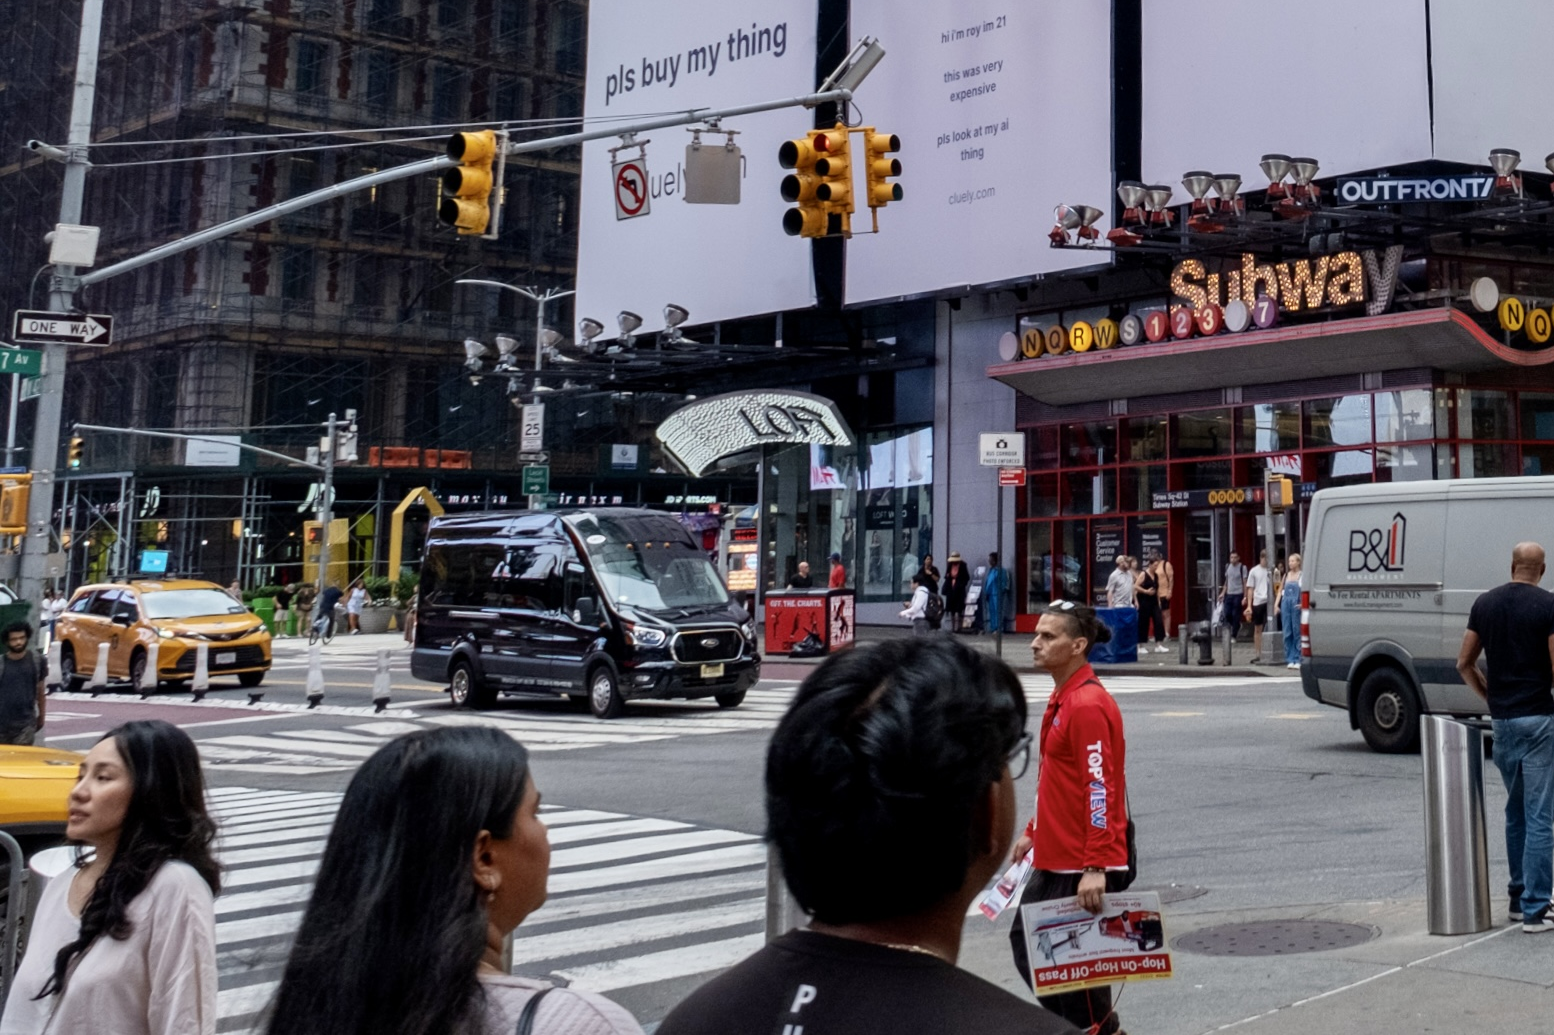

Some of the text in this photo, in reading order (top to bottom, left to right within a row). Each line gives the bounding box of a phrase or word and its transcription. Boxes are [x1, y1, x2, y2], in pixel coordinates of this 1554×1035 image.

[606, 23, 787, 106] pls buy my thing
[1171, 245, 1404, 316] Subway
[30, 321, 97, 335] ONE WAY
[1, 352, 10, 369] 7
[525, 424, 540, 436] 25
[740, 405, 836, 440] LOFT
[1087, 740, 1107, 829] TOPVIEW
[1038, 957, 1166, 982] Hop-On Hop-Off Pass
